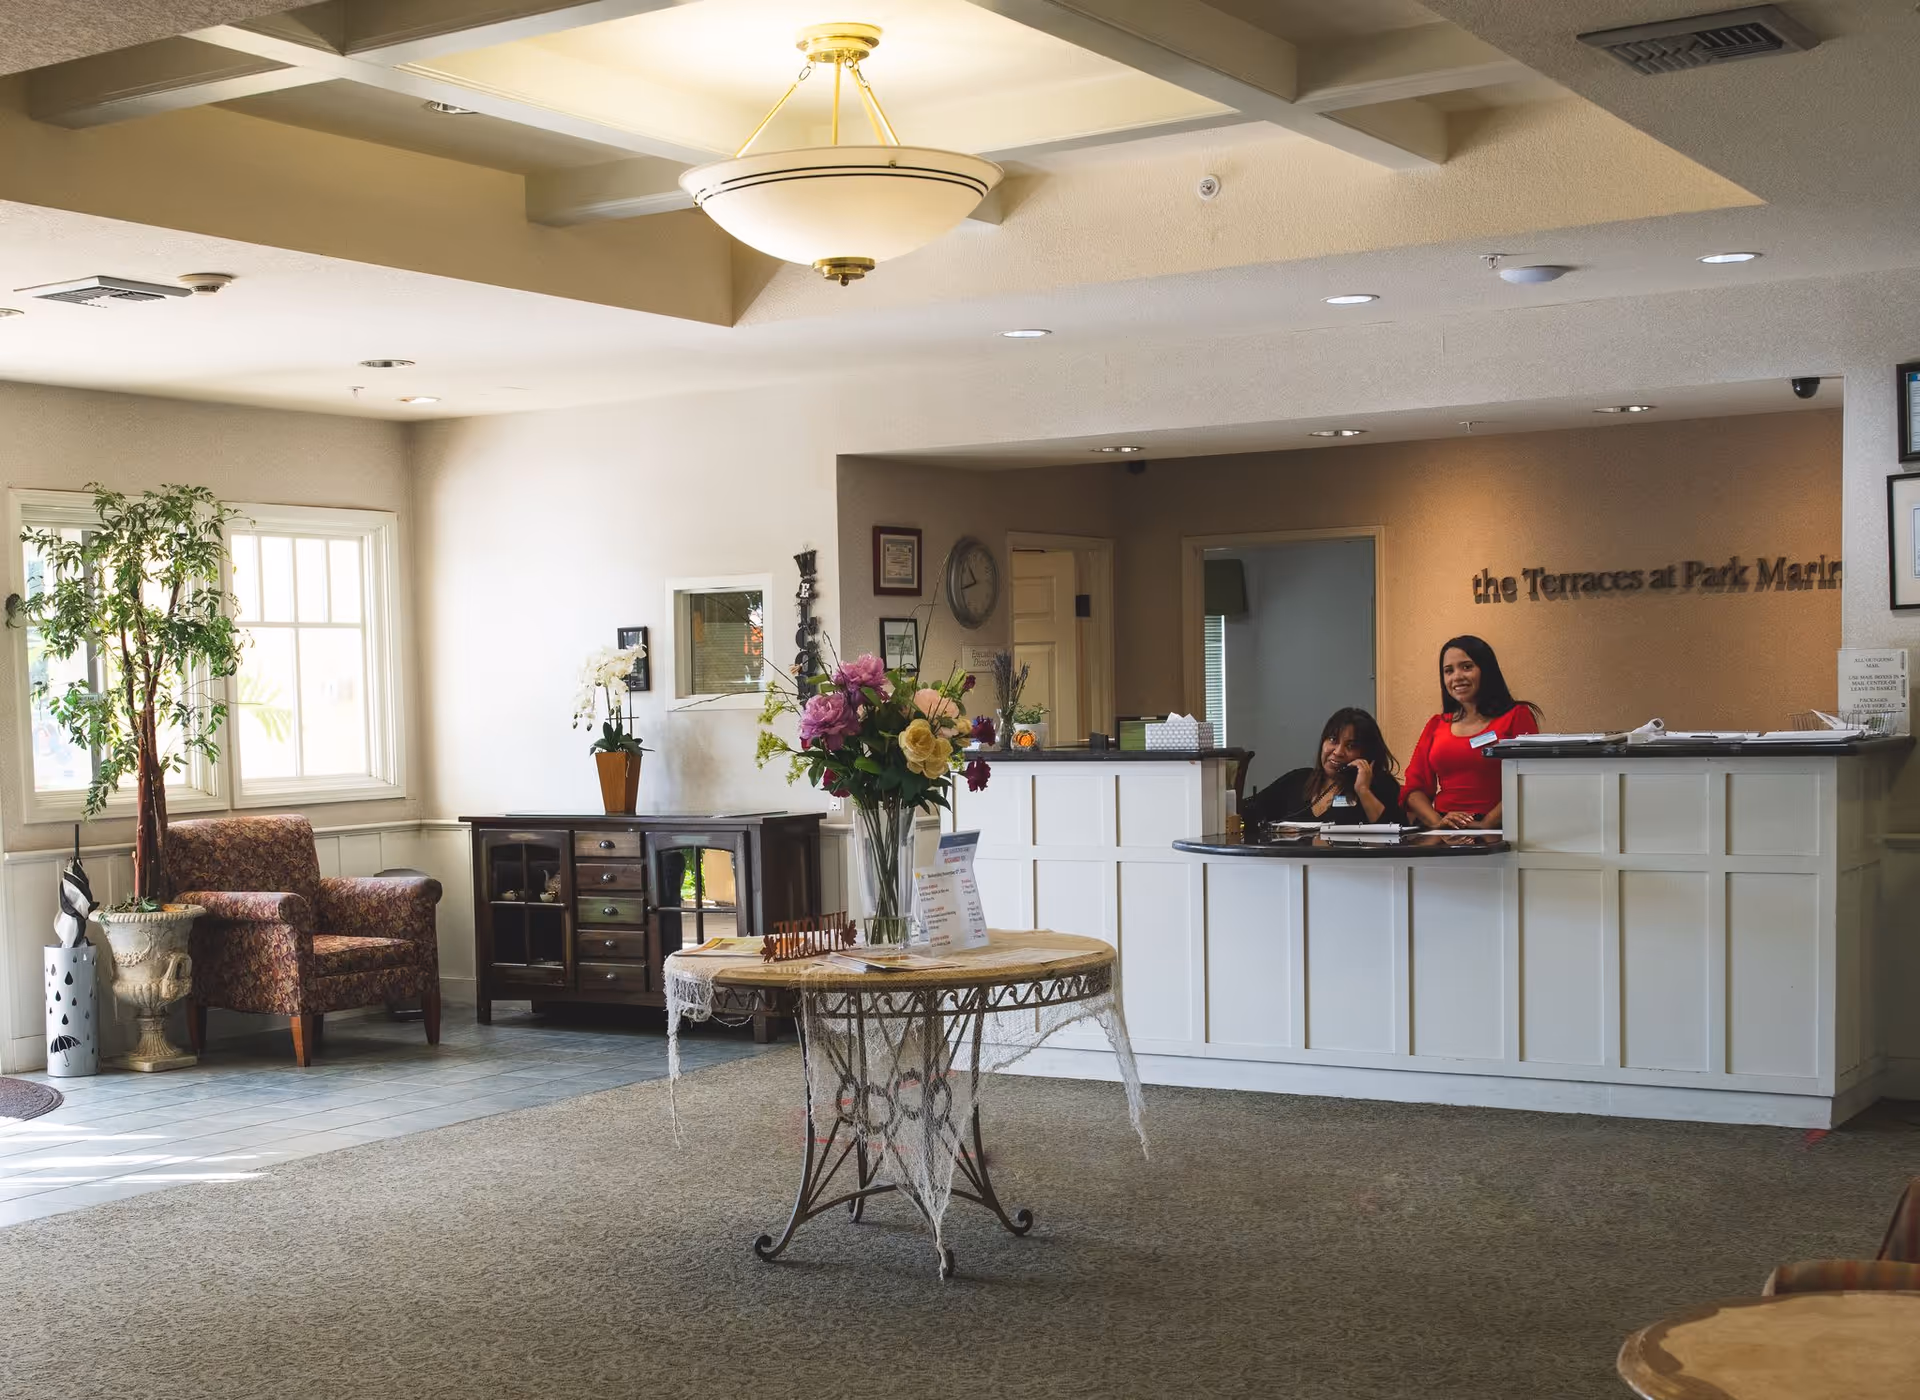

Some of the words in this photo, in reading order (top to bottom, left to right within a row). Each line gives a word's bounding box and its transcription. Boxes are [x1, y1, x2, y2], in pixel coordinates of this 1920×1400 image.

[793, 549, 820, 708] WELCOM
[1472, 568, 1517, 602] the
[1522, 566, 1645, 599] Terraces
[1649, 563, 1678, 594] at
[1682, 555, 1750, 592] Park
